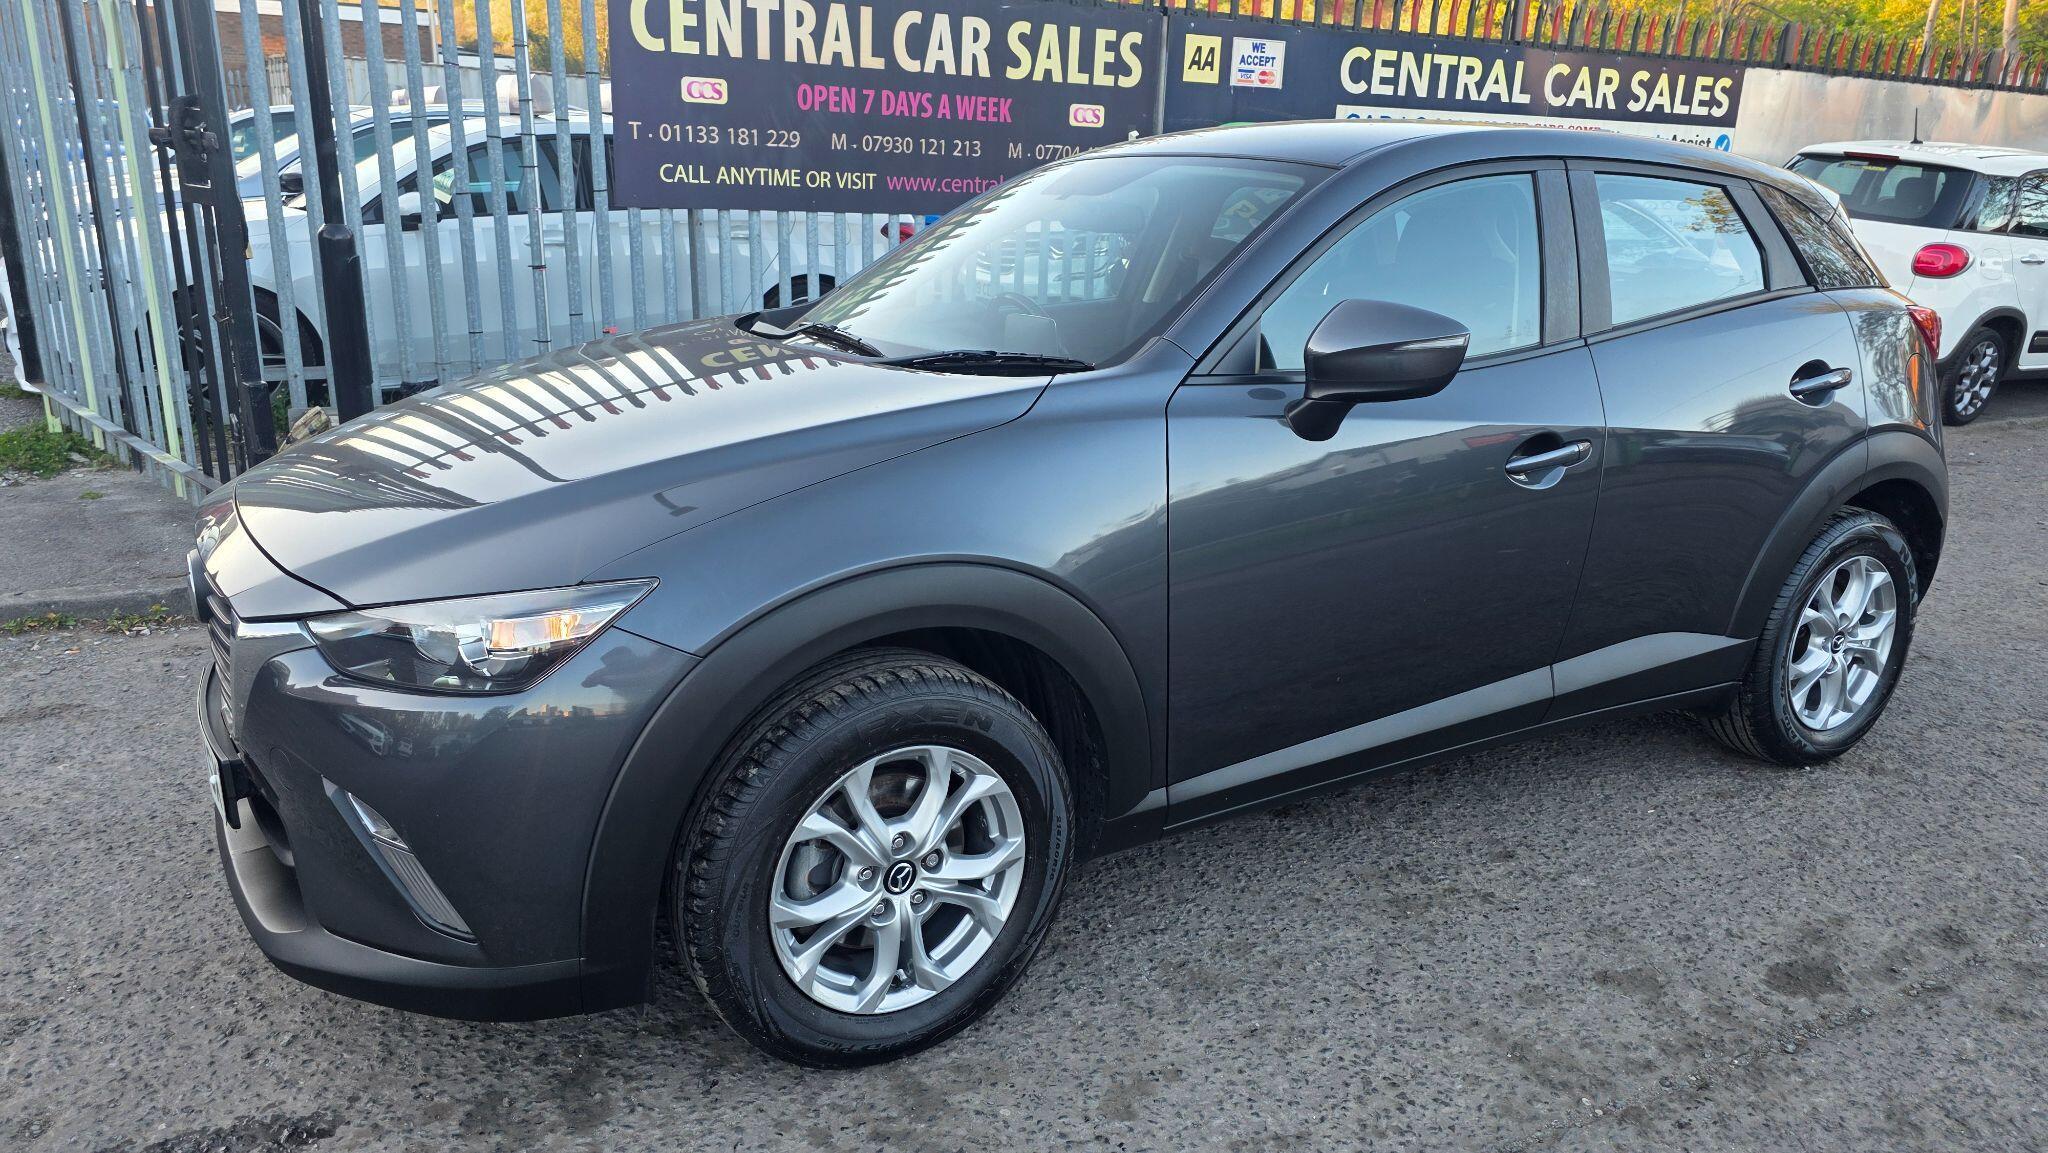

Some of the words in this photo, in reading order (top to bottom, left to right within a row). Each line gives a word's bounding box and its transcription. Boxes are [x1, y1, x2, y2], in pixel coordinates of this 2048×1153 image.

[630, 0, 885, 70] CENTRAL
[893, 10, 991, 78] CAR
[1005, 21, 1143, 88] SALES
[1252, 42, 1266, 54] WE
[1188, 46, 1215, 71] AA
[1239, 55, 1276, 67] ACCEPT
[687, 81, 723, 100] CCS
[1340, 46, 1531, 104] CENTRAL
[1544, 63, 1616, 109] CAR
[1626, 70, 1733, 118] SALES
[797, 83, 856, 114] OPEN
[862, 89, 875, 114] 7
[881, 90, 933, 119] DAYS
[937, 94, 951, 119] A
[956, 94, 1012, 123] WEEK
[1073, 107, 1101, 124] CCS
[659, 123, 719, 144] 01133
[728, 127, 758, 147] 181
[765, 129, 801, 148] 229
[862, 134, 913, 154] 07930
[919, 138, 945, 155] 121
[953, 139, 981, 157] 213
[660, 163, 711, 184] CALL
[716, 166, 800, 187] ANYTIME
[806, 170, 831, 188] OR
[836, 171, 877, 190] VISIT
